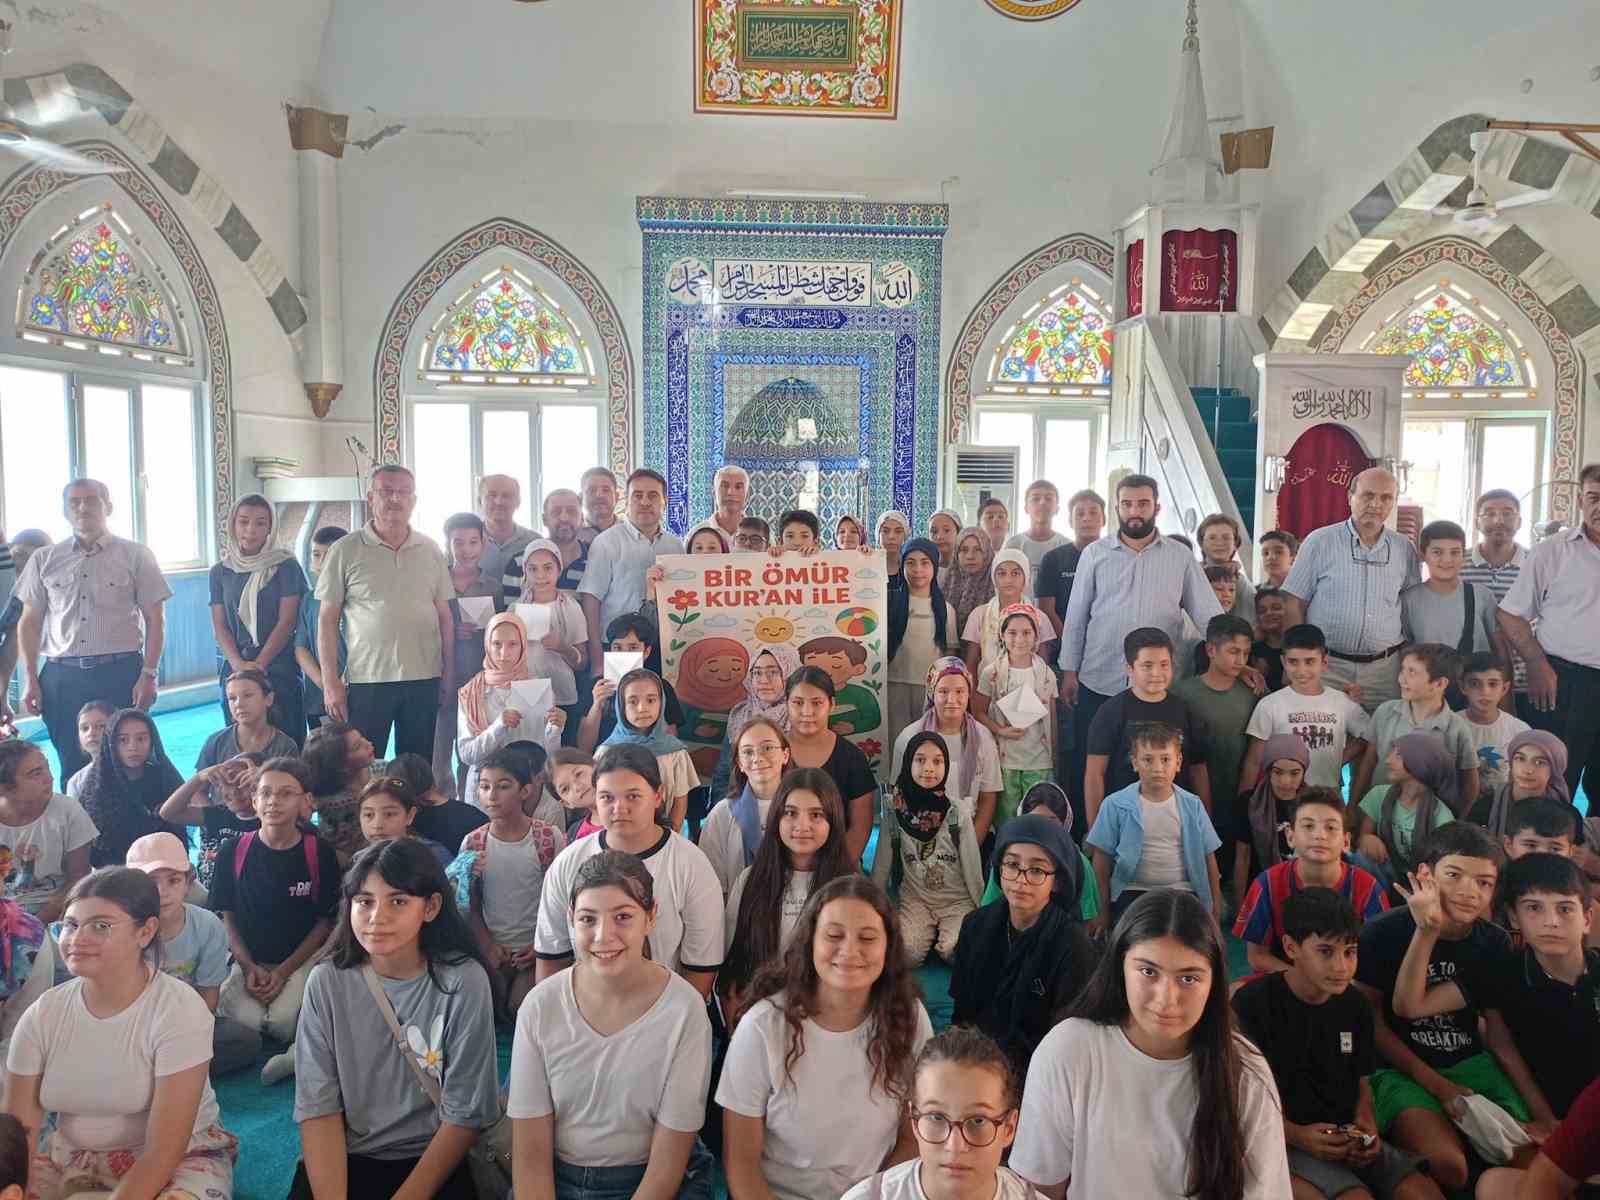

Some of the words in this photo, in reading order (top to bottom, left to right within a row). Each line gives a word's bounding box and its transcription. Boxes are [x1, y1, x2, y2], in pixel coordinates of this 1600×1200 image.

[704, 565, 752, 587] BİR
[762, 562, 849, 585] ÖMÜR
[1440, 961, 1456, 975] TO
